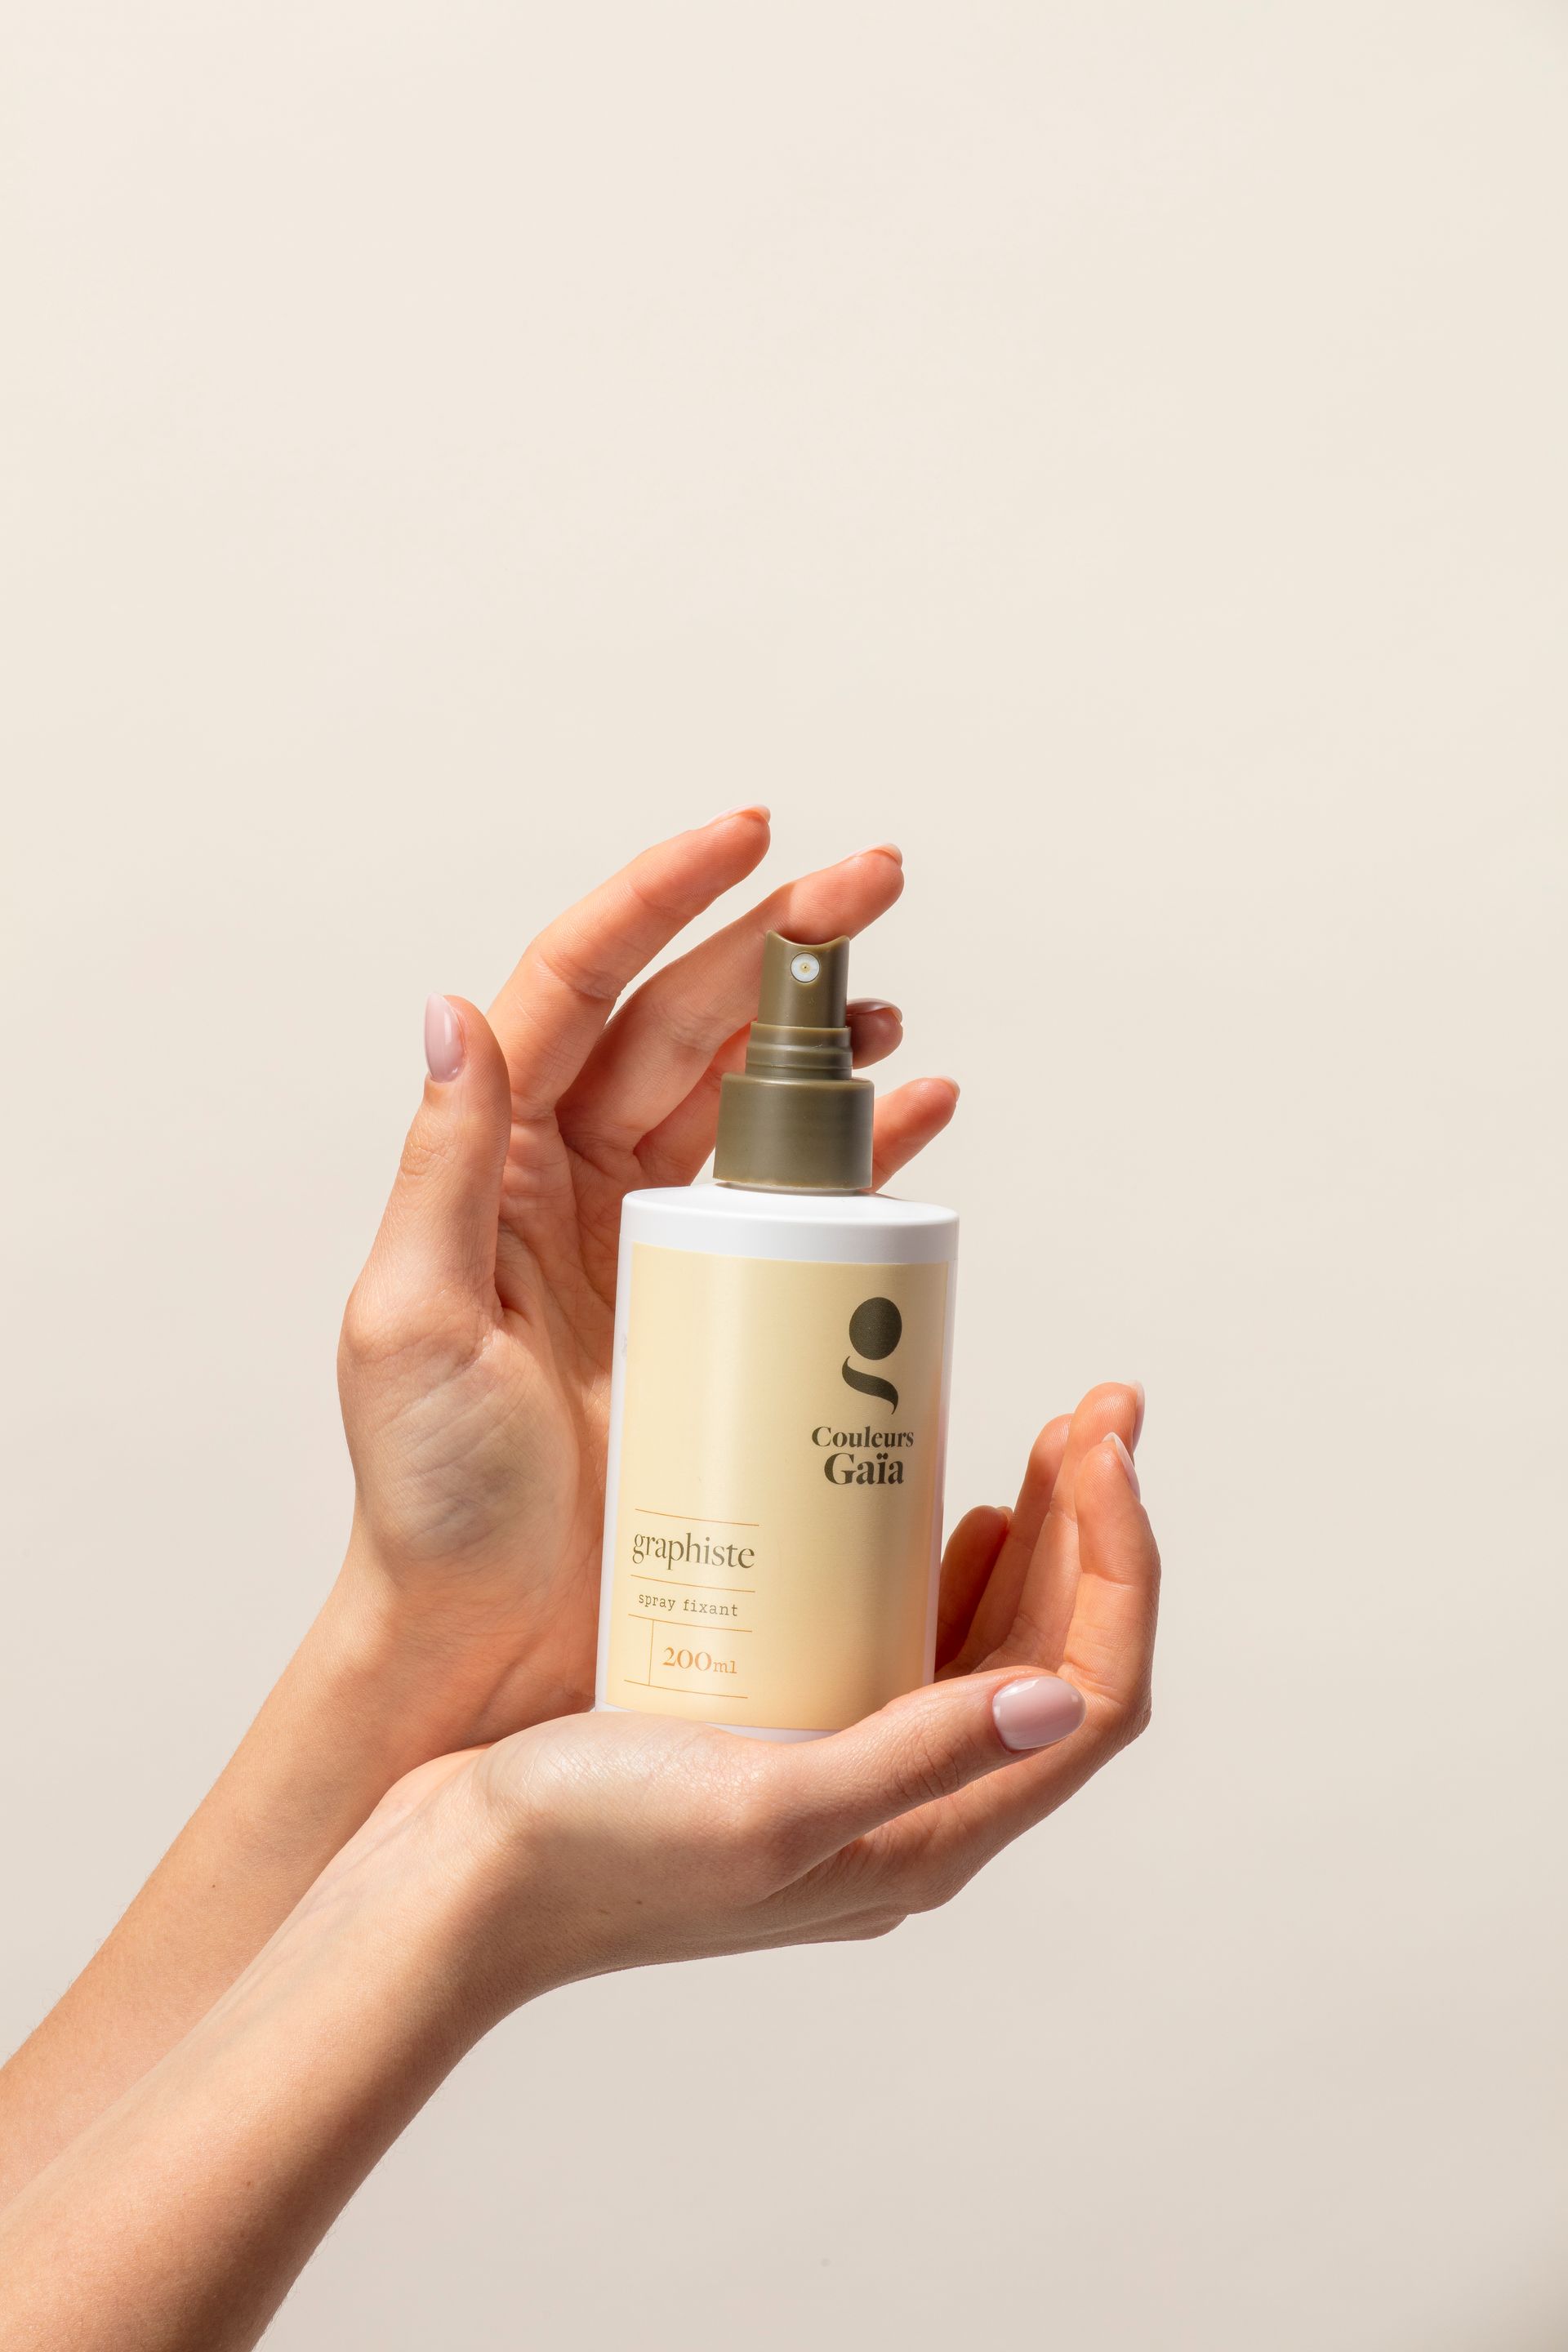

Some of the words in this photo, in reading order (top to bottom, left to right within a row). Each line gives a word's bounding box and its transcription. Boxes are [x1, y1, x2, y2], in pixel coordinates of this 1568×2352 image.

[811, 1425, 915, 1449] Couleurs
[823, 1451, 905, 1486] Gaïa
[631, 1532, 755, 1571] graphiste
[638, 1593, 676, 1611] spray
[683, 1599, 738, 1617] fixant
[662, 1646, 738, 1674] 200ml
